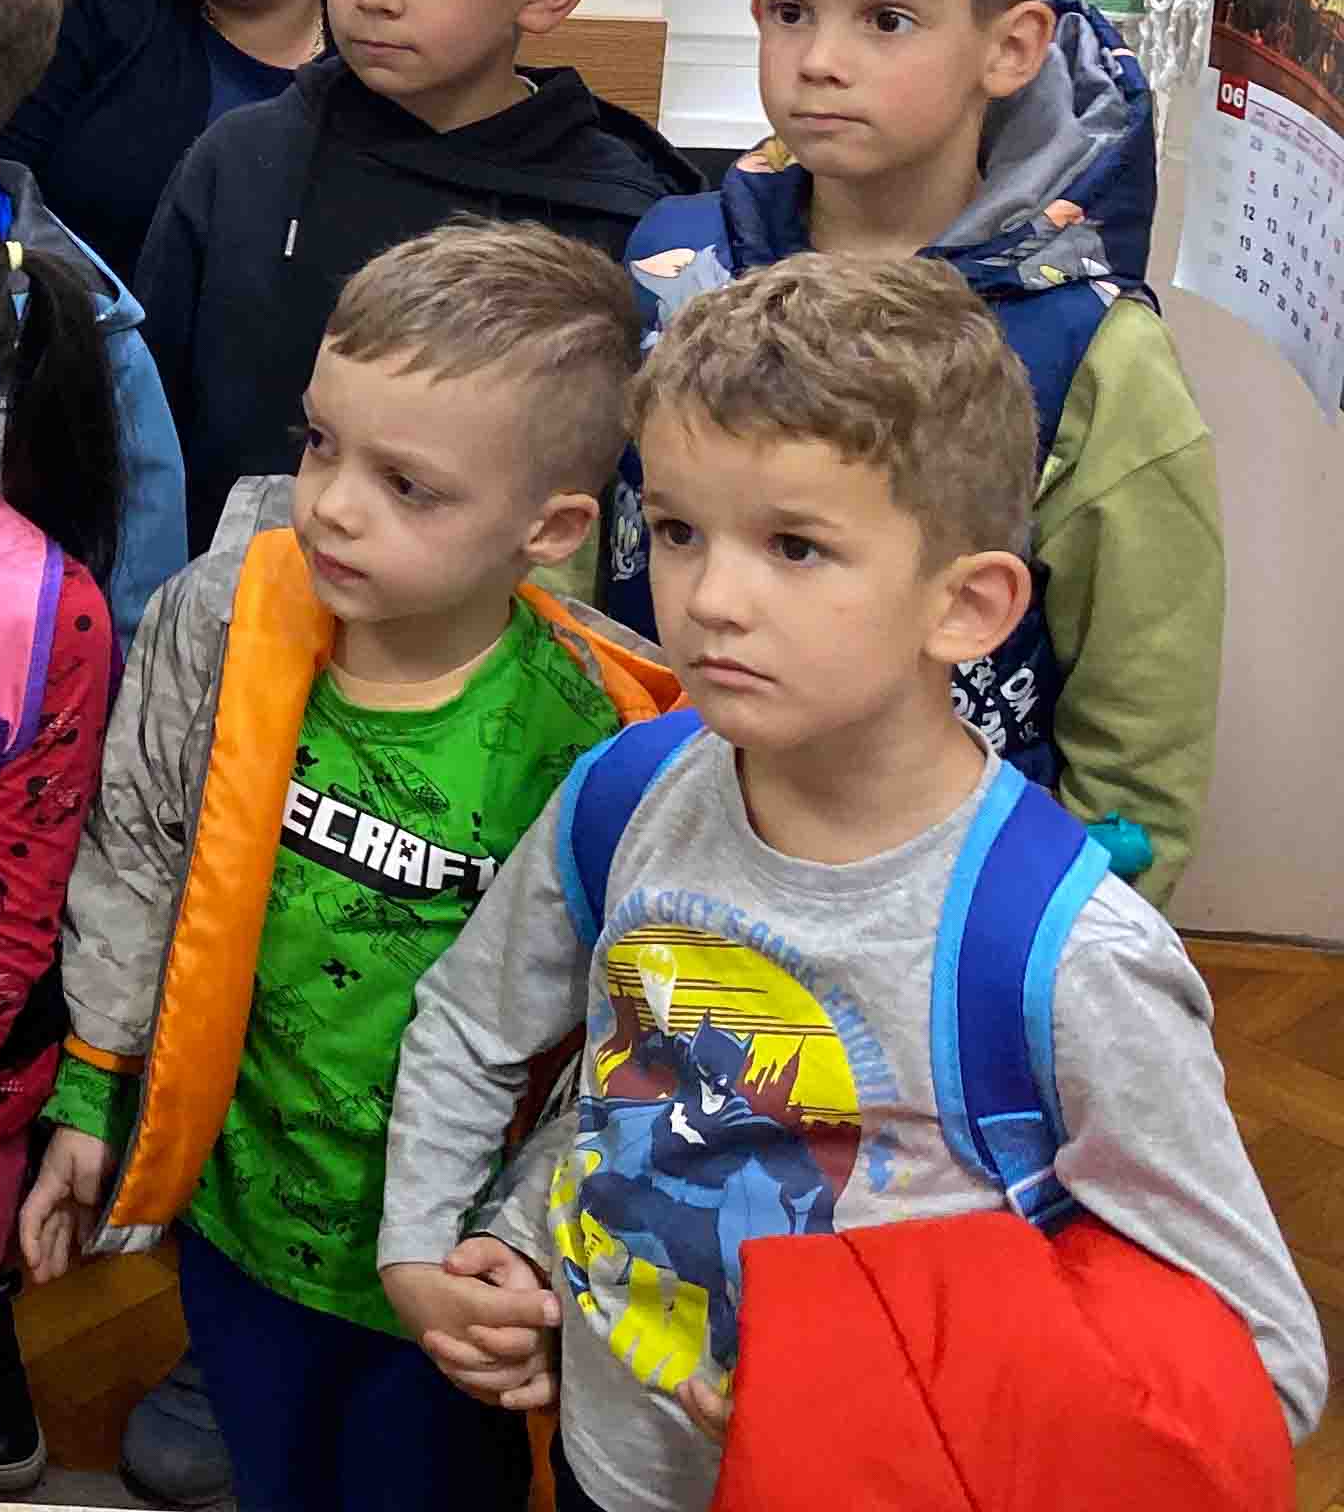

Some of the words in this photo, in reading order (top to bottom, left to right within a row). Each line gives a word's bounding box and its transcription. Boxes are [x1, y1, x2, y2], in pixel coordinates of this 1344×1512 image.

[1221, 83, 1245, 108] 06
[1273, 183, 1279, 198] 6
[1243, 203, 1256, 220] 12
[1267, 217, 1278, 234] 13
[1240, 235, 1252, 251] 19
[1235, 265, 1248, 282] 26
[1258, 279, 1270, 296] 27
